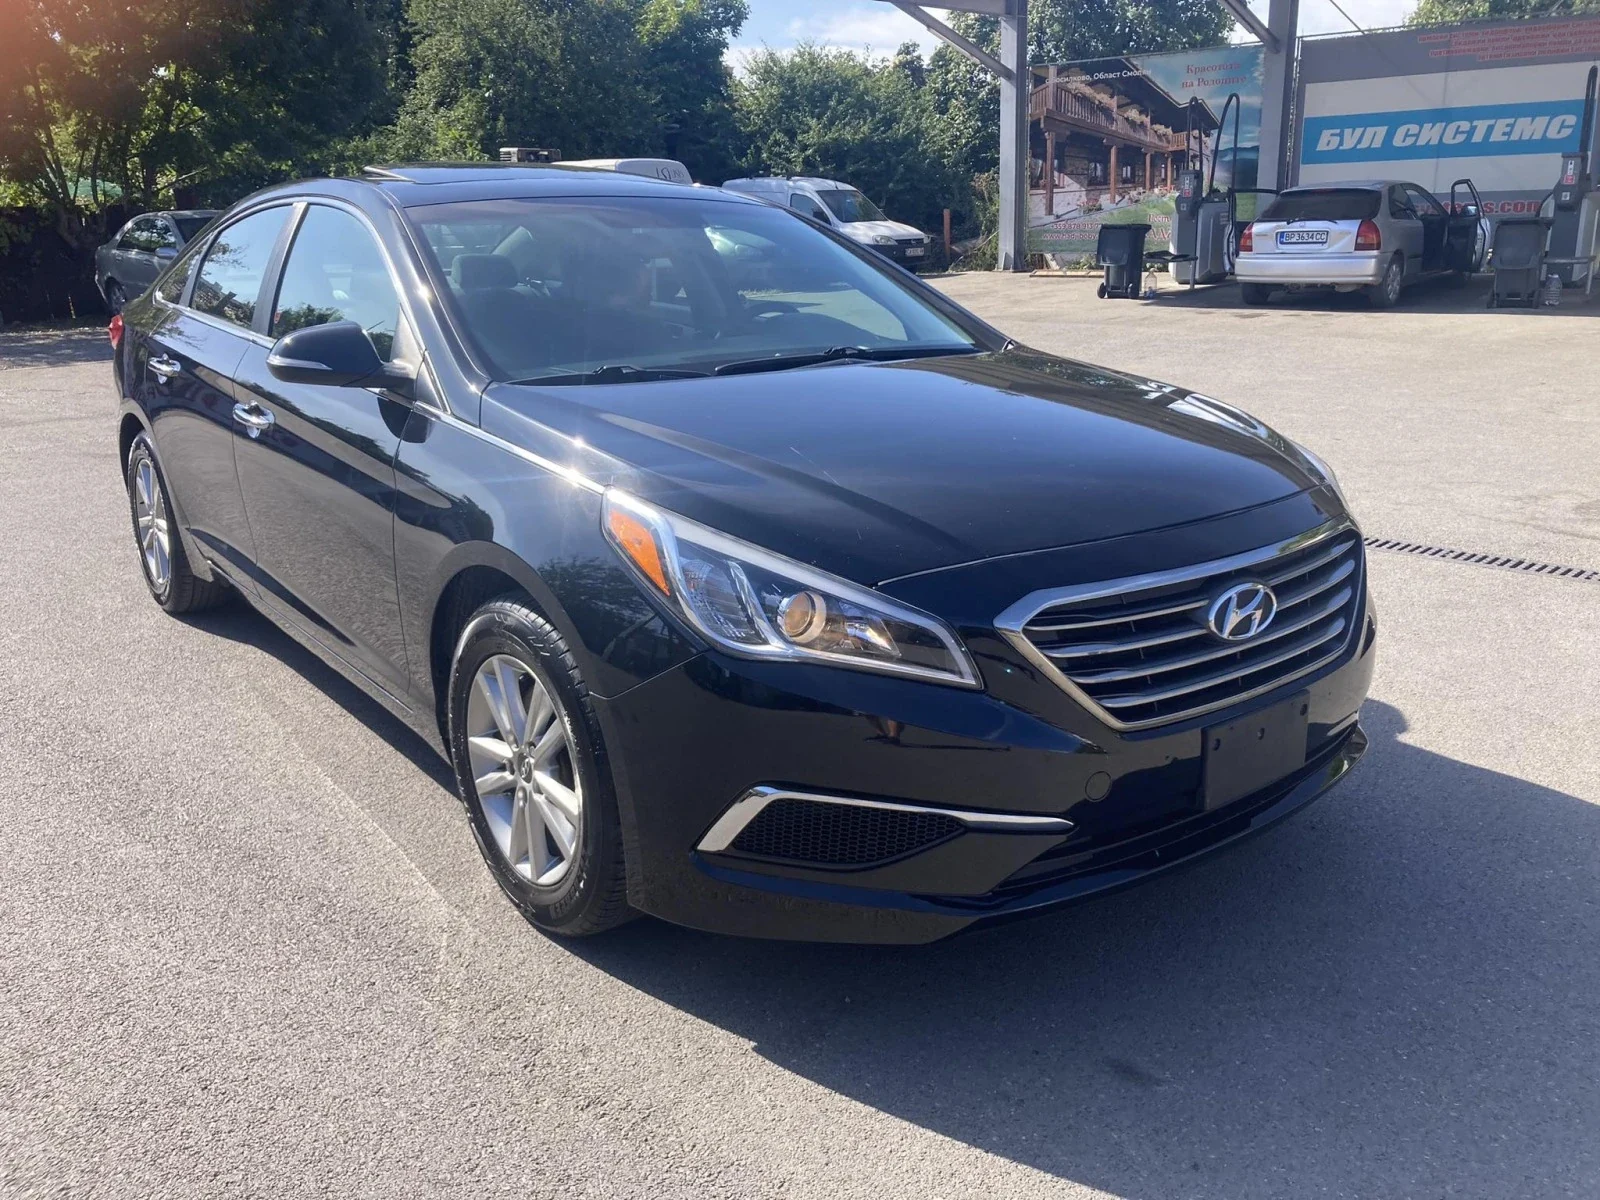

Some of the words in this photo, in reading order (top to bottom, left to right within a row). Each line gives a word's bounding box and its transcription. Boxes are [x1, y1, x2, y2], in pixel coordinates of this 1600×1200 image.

[1093, 70, 1121, 80] Област
[1316, 126, 1388, 151] БУЛ
[1392, 114, 1577, 148] СИСТЕМС
